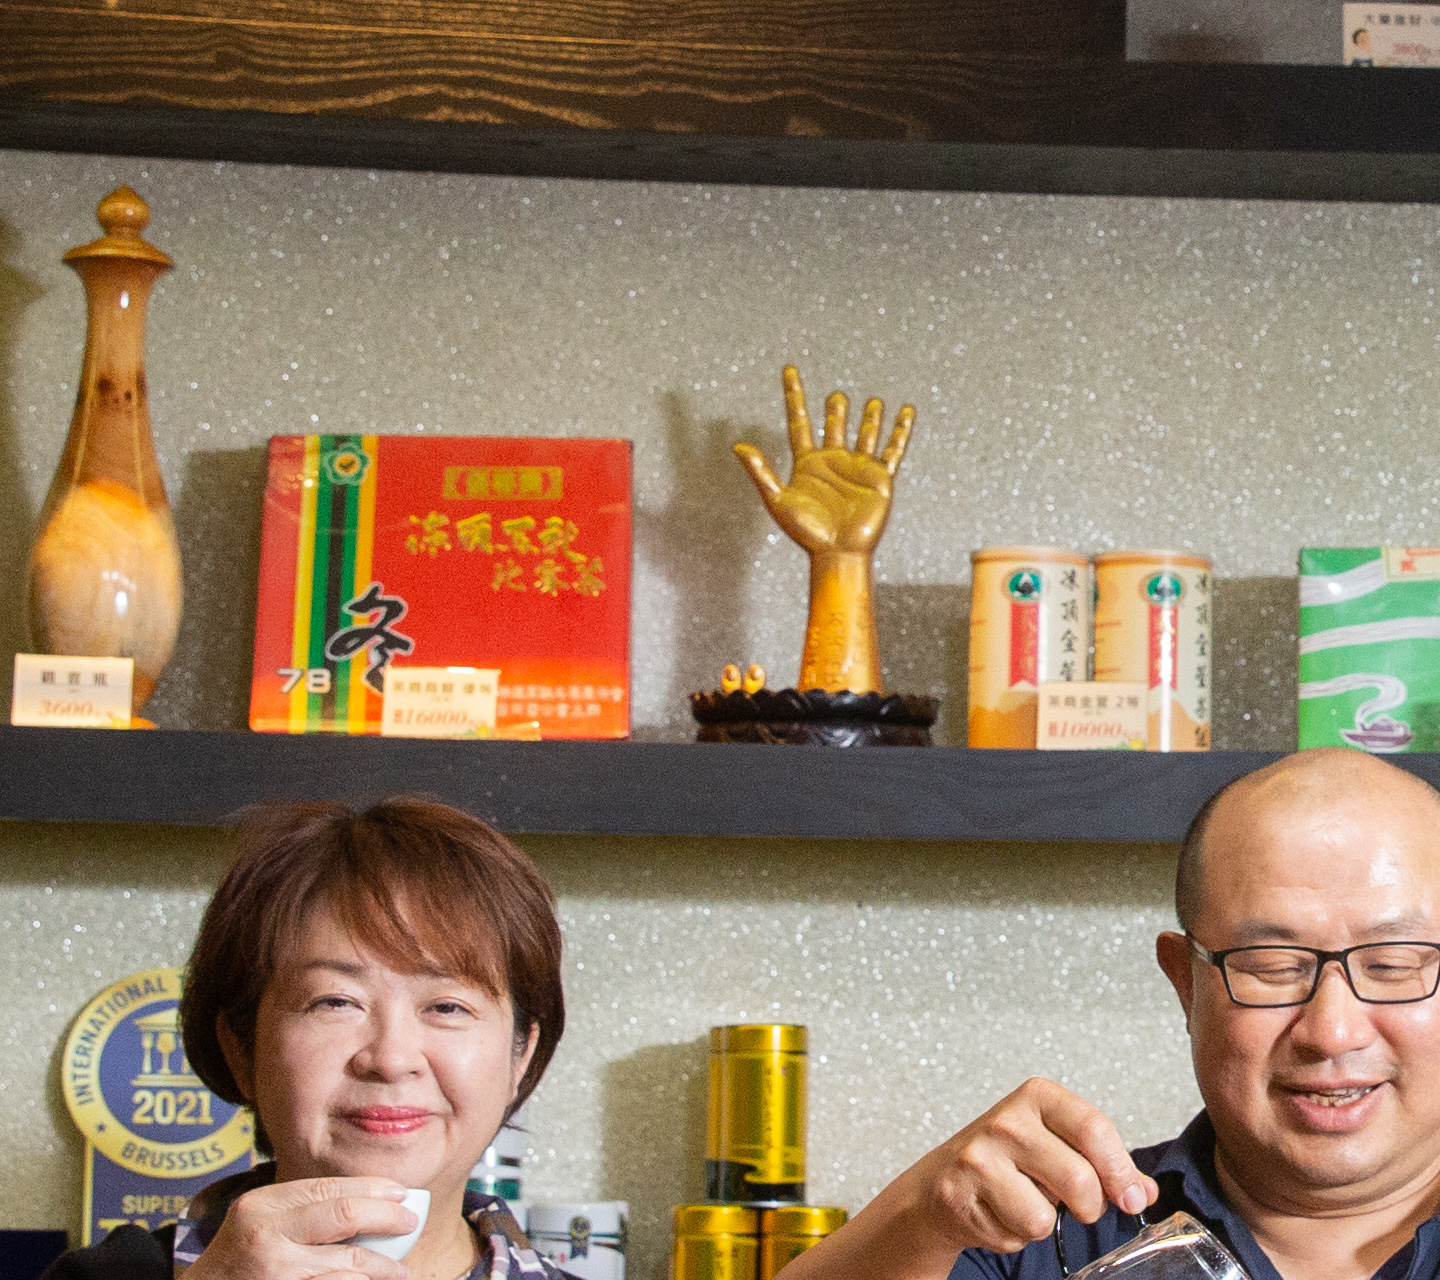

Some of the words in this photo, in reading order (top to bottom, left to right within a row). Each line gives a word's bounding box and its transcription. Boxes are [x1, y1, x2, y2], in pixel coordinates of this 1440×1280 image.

[276, 667, 332, 695] 78
[72, 974, 167, 1106] INTERNATIONAL
[132, 1090, 214, 1126] 2021
[120, 1140, 225, 1172] BRUSSELS
